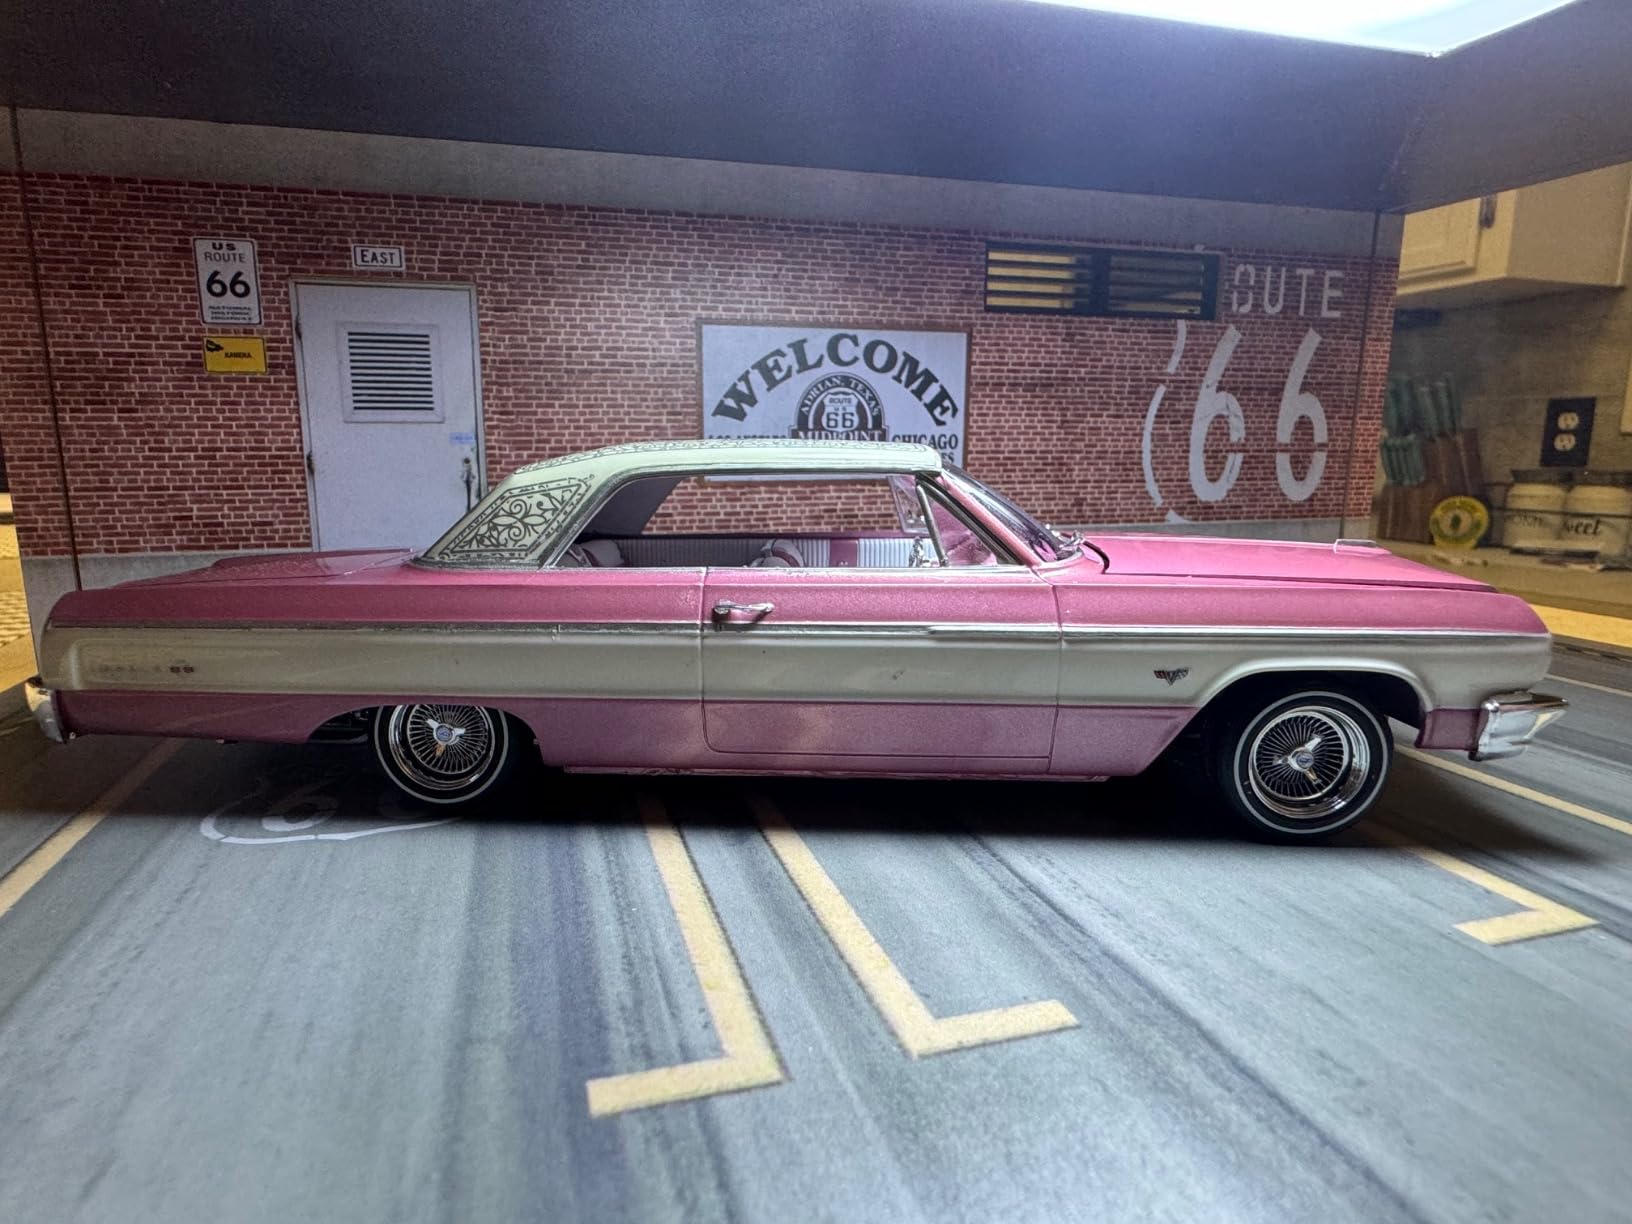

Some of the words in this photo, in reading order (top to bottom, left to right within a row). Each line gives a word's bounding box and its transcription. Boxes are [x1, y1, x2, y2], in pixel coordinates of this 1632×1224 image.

[204, 251, 246, 263] ROUTE
[211, 241, 236, 251] US
[360, 249, 396, 265] EAST
[206, 270, 251, 298] 66
[1232, 263, 1345, 318] OUTE
[711, 332, 960, 427] WELCOME
[800, 376, 845, 416] ADRIAN,
[848, 378, 881, 416] TEXAS
[826, 411, 855, 429] 66
[1189, 323, 1328, 501] 66
